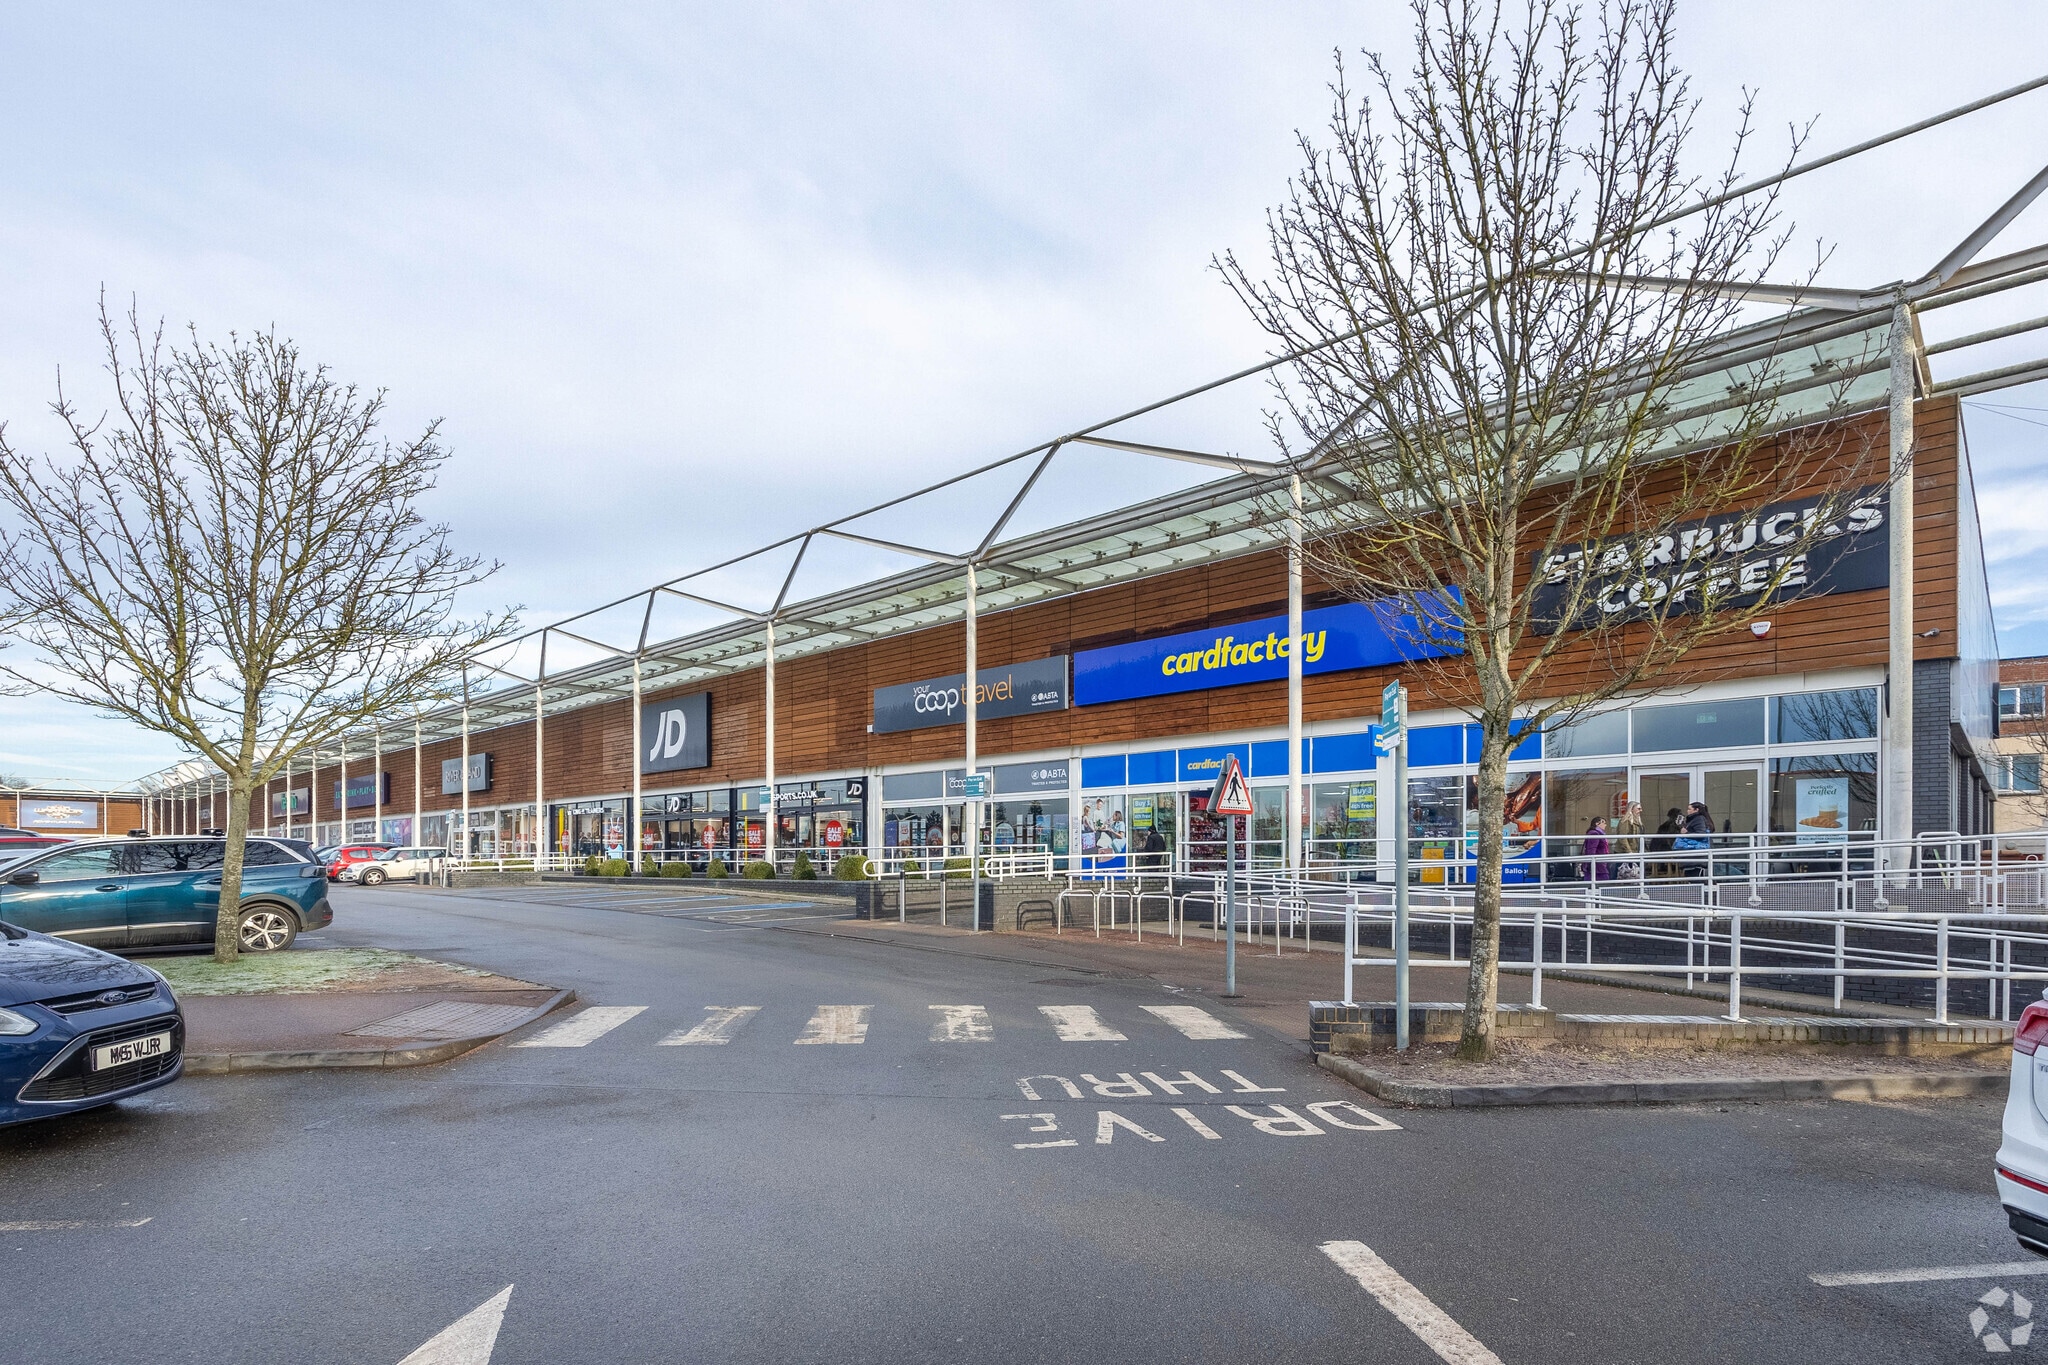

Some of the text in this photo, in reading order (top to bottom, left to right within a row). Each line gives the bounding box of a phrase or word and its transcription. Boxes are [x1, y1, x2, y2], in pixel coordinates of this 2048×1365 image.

[913, 685, 930, 697] your
[961, 674, 1013, 705] tavel
[1043, 691, 1059, 700] ABTA
[650, 709, 686, 762] JD
[1047, 769, 1067, 779] ABTA
[848, 783, 862, 795] JD
[1352, 787, 1366, 795] Buy
[668, 796, 680, 812] JD
[1015, 1069, 1287, 1101] THRU
[1000, 1100, 1403, 1150] DRIVE
